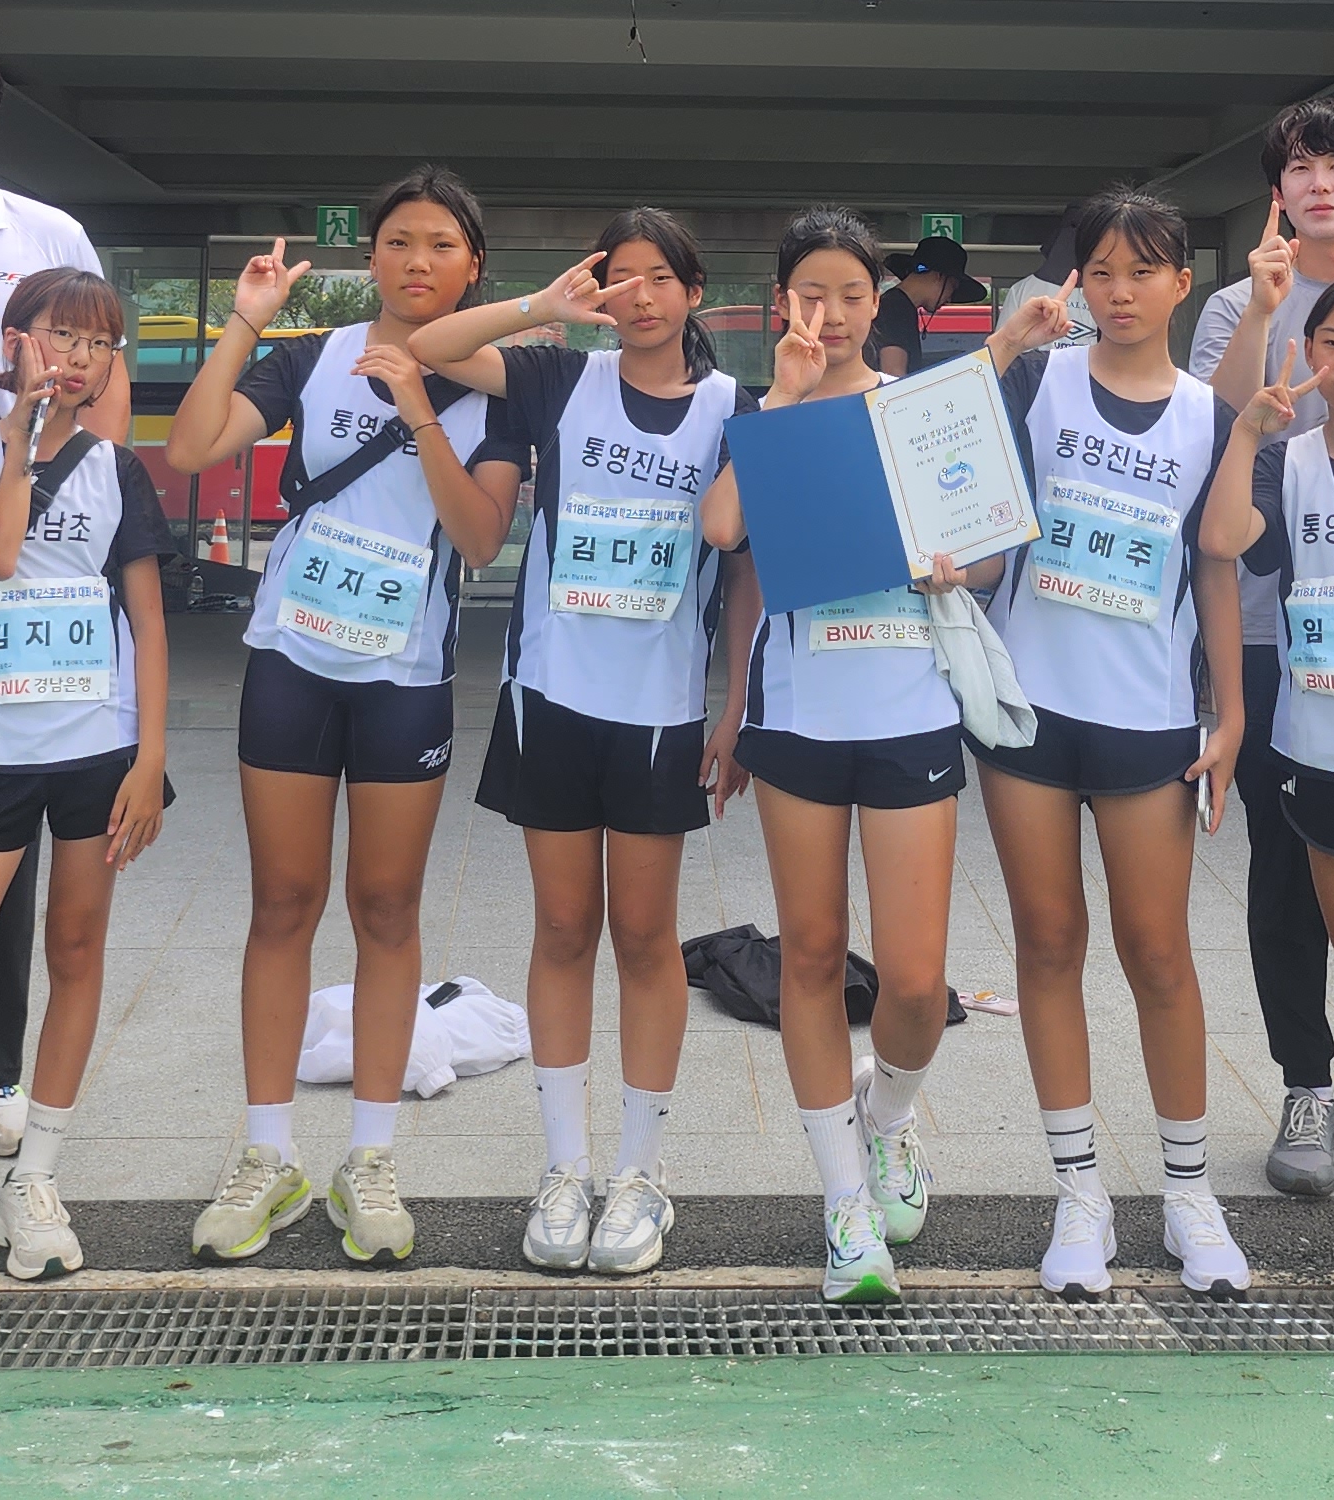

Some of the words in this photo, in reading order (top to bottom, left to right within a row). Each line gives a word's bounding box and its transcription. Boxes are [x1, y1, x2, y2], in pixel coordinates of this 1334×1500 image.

[581, 436, 702, 496] 통영진남초
[1056, 428, 1182, 489] 통영진남초
[566, 590, 612, 609] BNK
[614, 593, 666, 613] 경남은행
[1038, 573, 1084, 600] BNK
[1087, 585, 1144, 615] 경남은행
[295, 608, 334, 636] BNK
[334, 622, 389, 649] 경남은행
[826, 623, 875, 642] BNK
[877, 623, 930, 641] 경남은행
[34, 676, 92, 694] 경남은행
